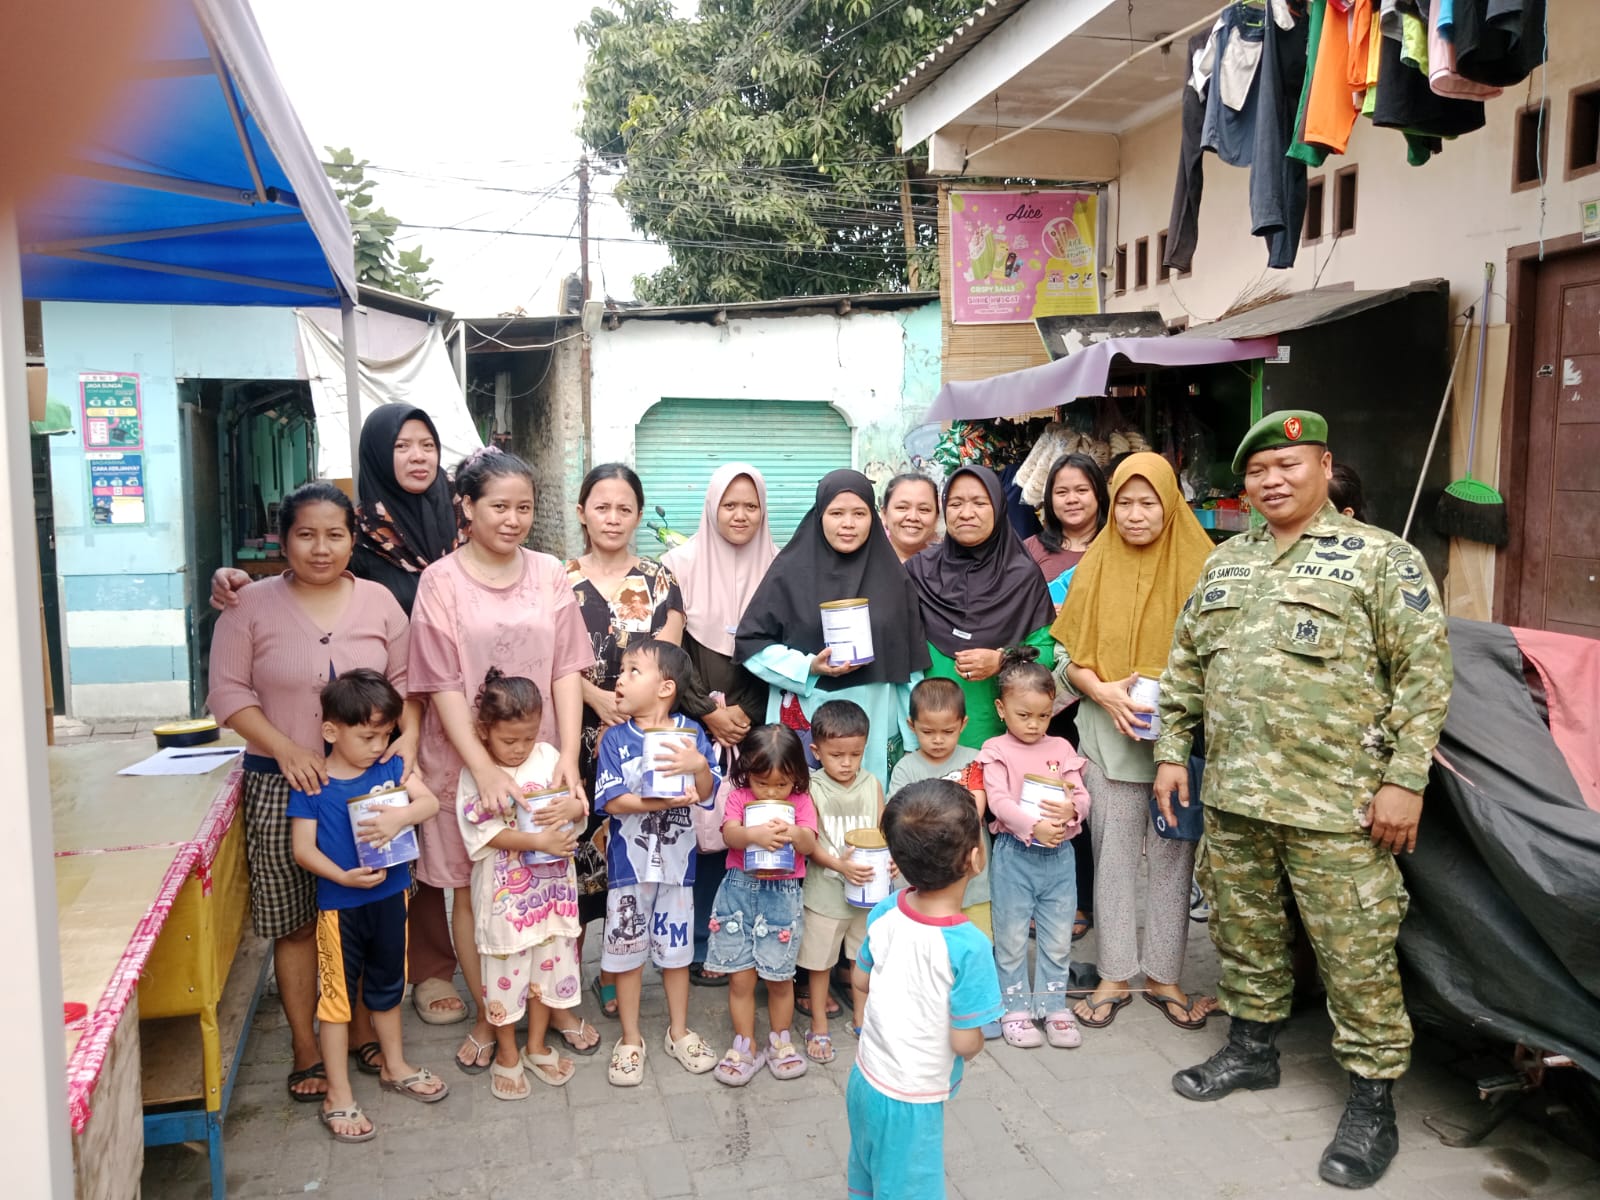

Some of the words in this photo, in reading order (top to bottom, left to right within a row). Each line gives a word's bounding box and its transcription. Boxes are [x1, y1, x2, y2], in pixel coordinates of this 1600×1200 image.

[1006, 204, 1043, 221] Aice
[1217, 566, 1251, 579] SANTOSO
[1296, 565, 1323, 576] TNI
[1328, 568, 1354, 581] AD
[618, 745, 630, 759] M
